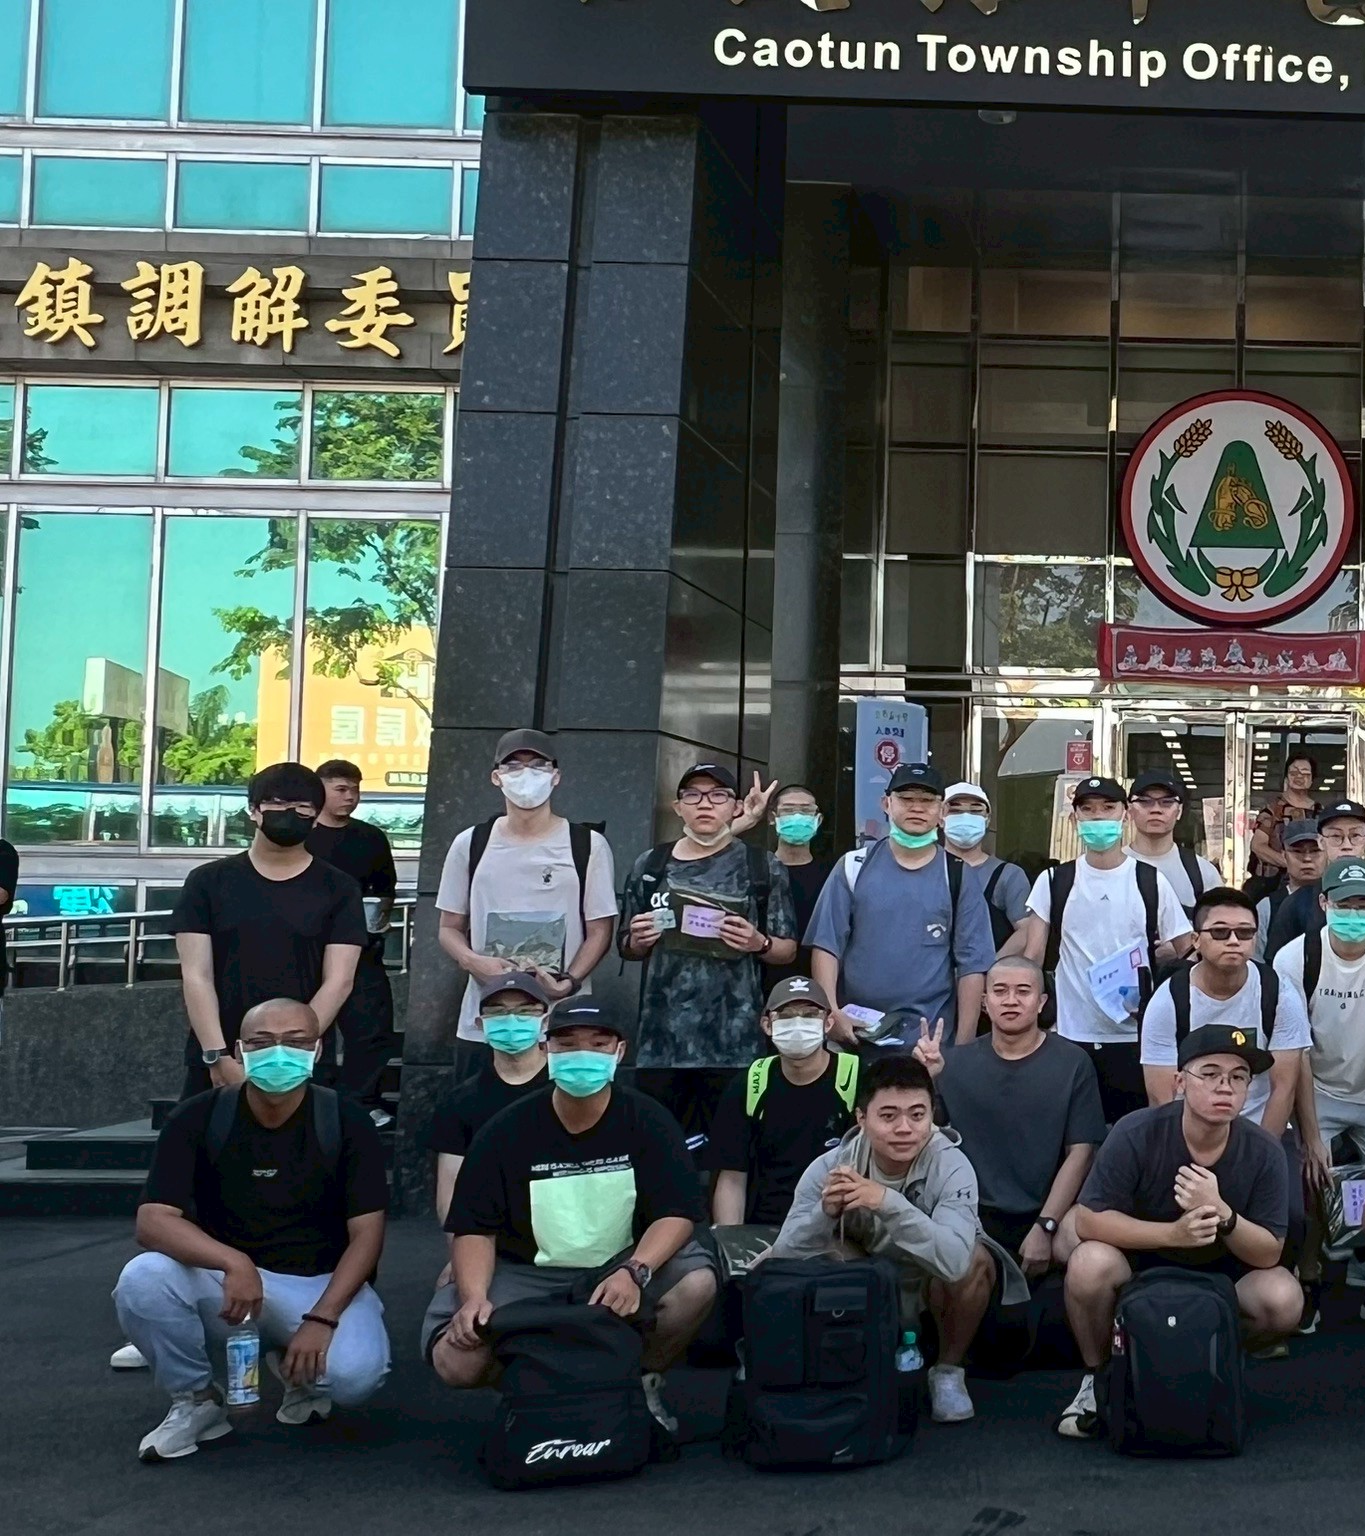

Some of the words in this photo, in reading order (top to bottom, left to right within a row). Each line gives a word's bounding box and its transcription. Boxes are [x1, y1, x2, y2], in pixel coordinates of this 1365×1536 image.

[714, 28, 900, 70] Caotun
[916, 34, 1167, 88] Township
[1182, 42, 1349, 92] Office,
